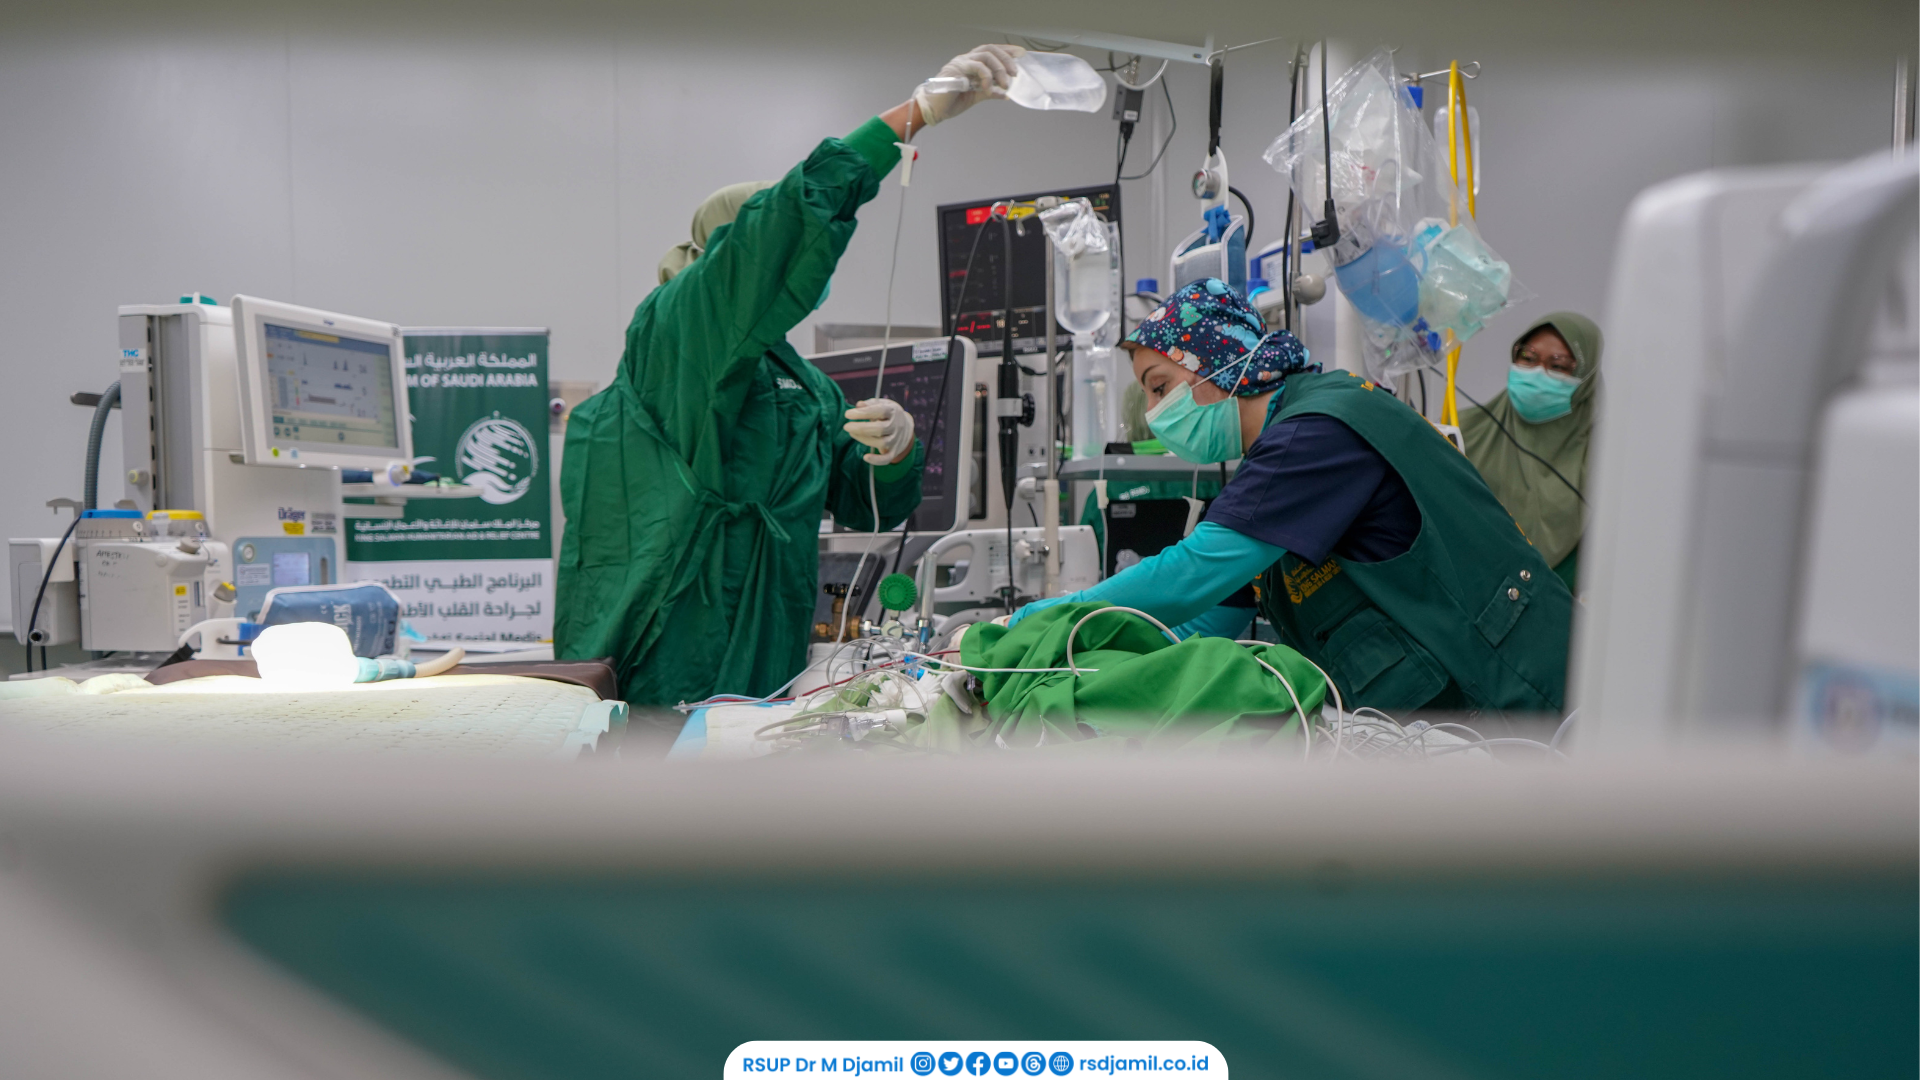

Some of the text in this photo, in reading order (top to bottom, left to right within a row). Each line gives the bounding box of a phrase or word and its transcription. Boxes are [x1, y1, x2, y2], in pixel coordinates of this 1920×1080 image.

[424, 352, 476, 371] العربية
[477, 352, 537, 369] المملكة
[420, 373, 440, 388] OF
[441, 373, 484, 388] SAUDI
[486, 373, 538, 387] ARABIA
[424, 573, 483, 593] الطبي
[486, 572, 542, 593] البرنامج
[438, 601, 479, 620] القلب
[484, 601, 541, 620] لجراحة
